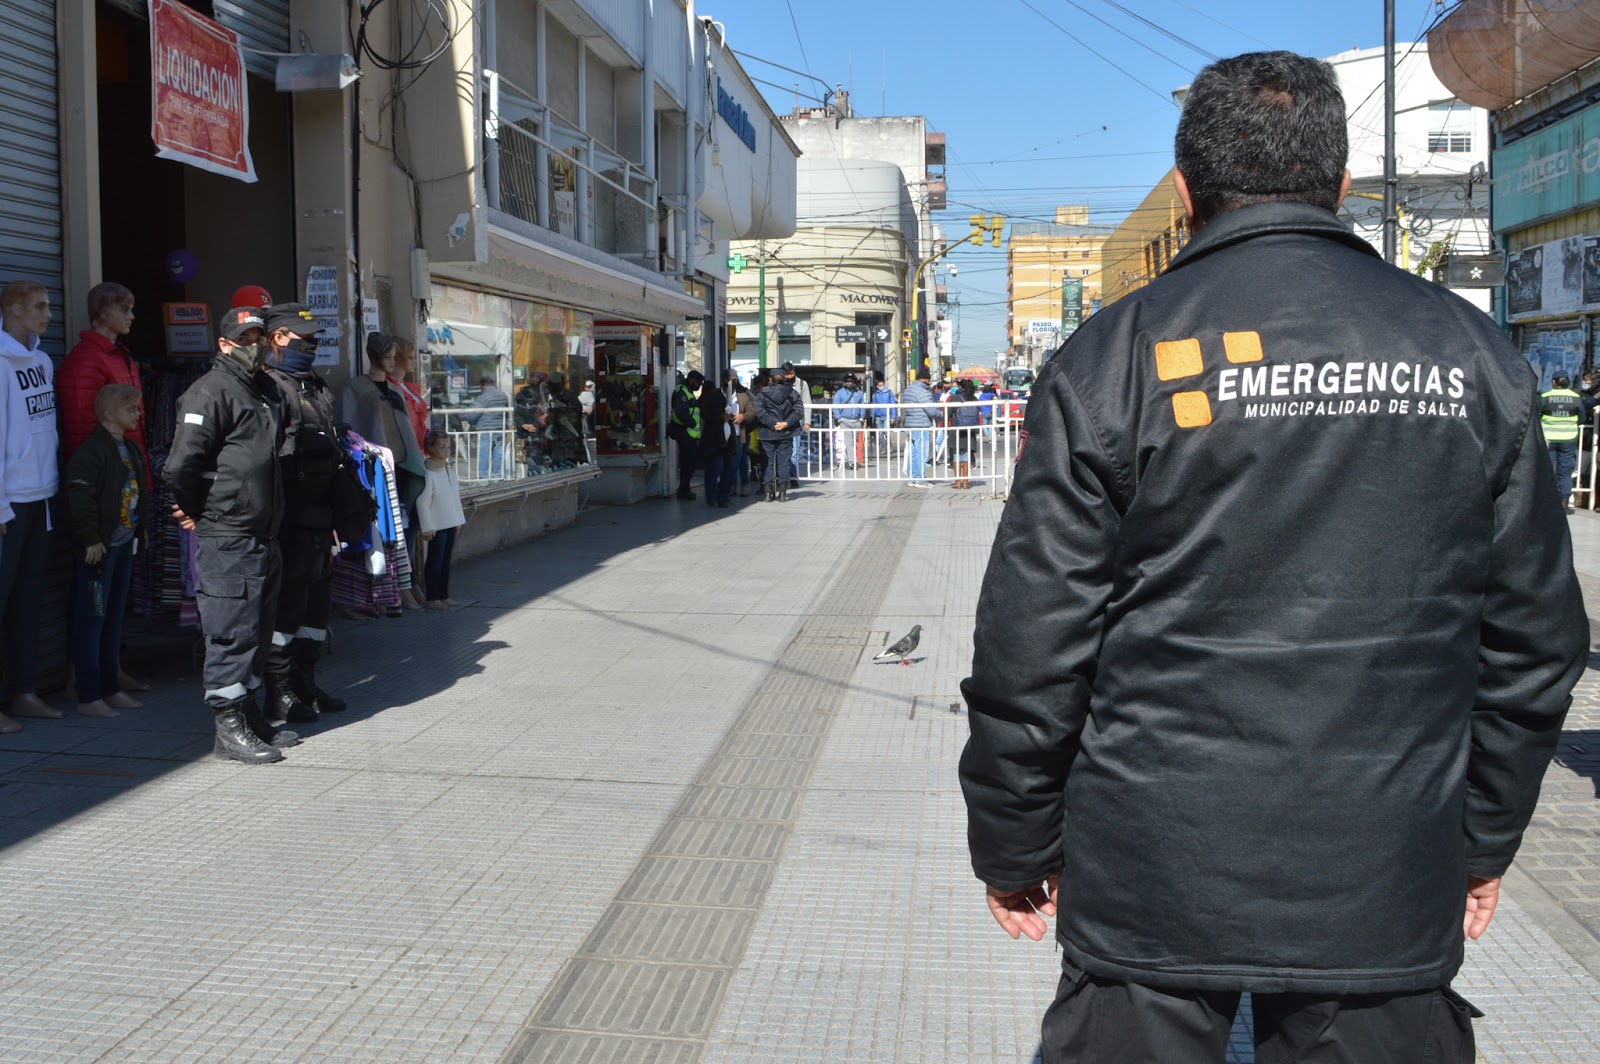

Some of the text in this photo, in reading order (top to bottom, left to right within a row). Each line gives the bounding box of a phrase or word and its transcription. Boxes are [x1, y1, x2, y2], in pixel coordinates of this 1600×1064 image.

[158, 43, 239, 114] LIQUIDACIÓN
[193, 104, 229, 128] TEMPORADA
[311, 269, 336, 280] ROHIBIDO
[309, 294, 337, 309] BARBIJO
[1218, 361, 1465, 401] EMERGENCIAS
[28, 393, 55, 414] PANIC
[1245, 398, 1467, 418] MUNICIPALIDAD DE SALTA
